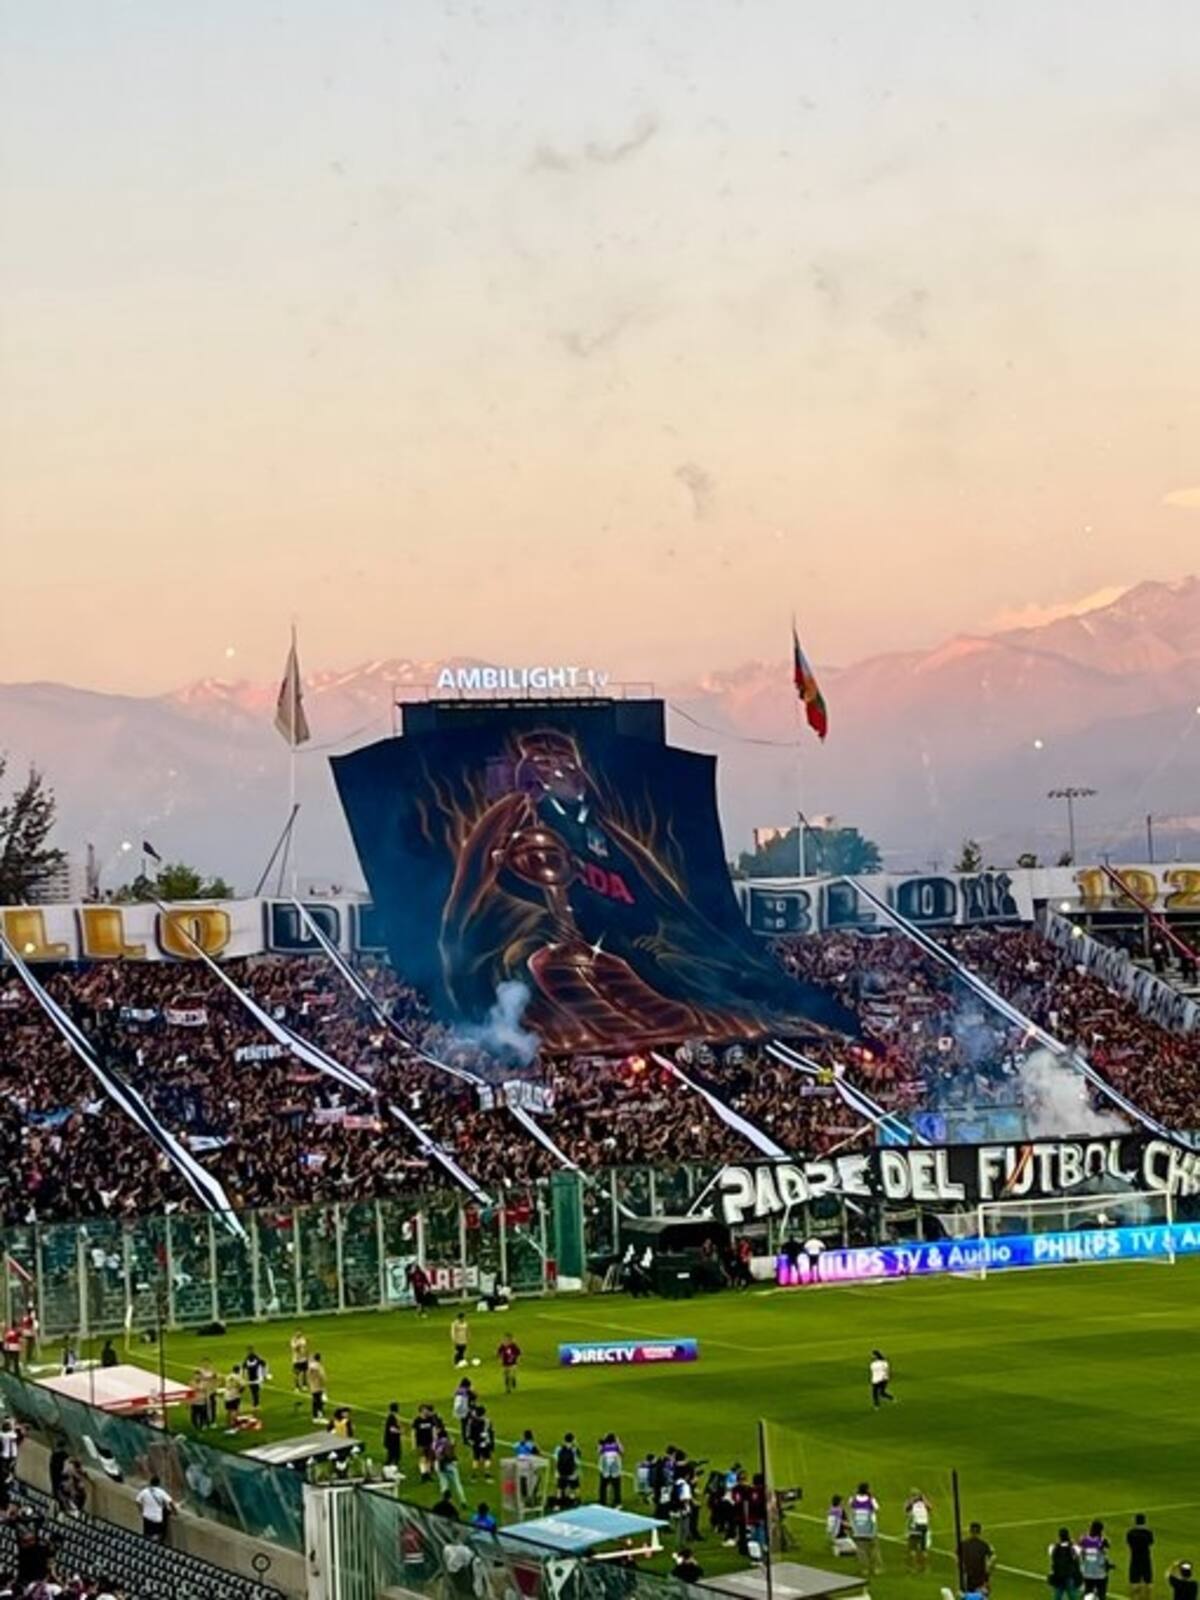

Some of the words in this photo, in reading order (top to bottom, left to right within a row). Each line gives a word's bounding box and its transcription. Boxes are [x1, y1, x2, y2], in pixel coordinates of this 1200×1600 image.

[437, 667, 580, 689] AMBILIGHT
[720, 1153, 872, 1225] PADRE
[881, 1148, 966, 1200] DEL
[896, 1248, 921, 1274] TV
[927, 1246, 944, 1268] &
[1032, 1229, 1121, 1260] PHILIPS
[1130, 1231, 1156, 1251] TV
[1181, 1228, 1200, 1249] A
